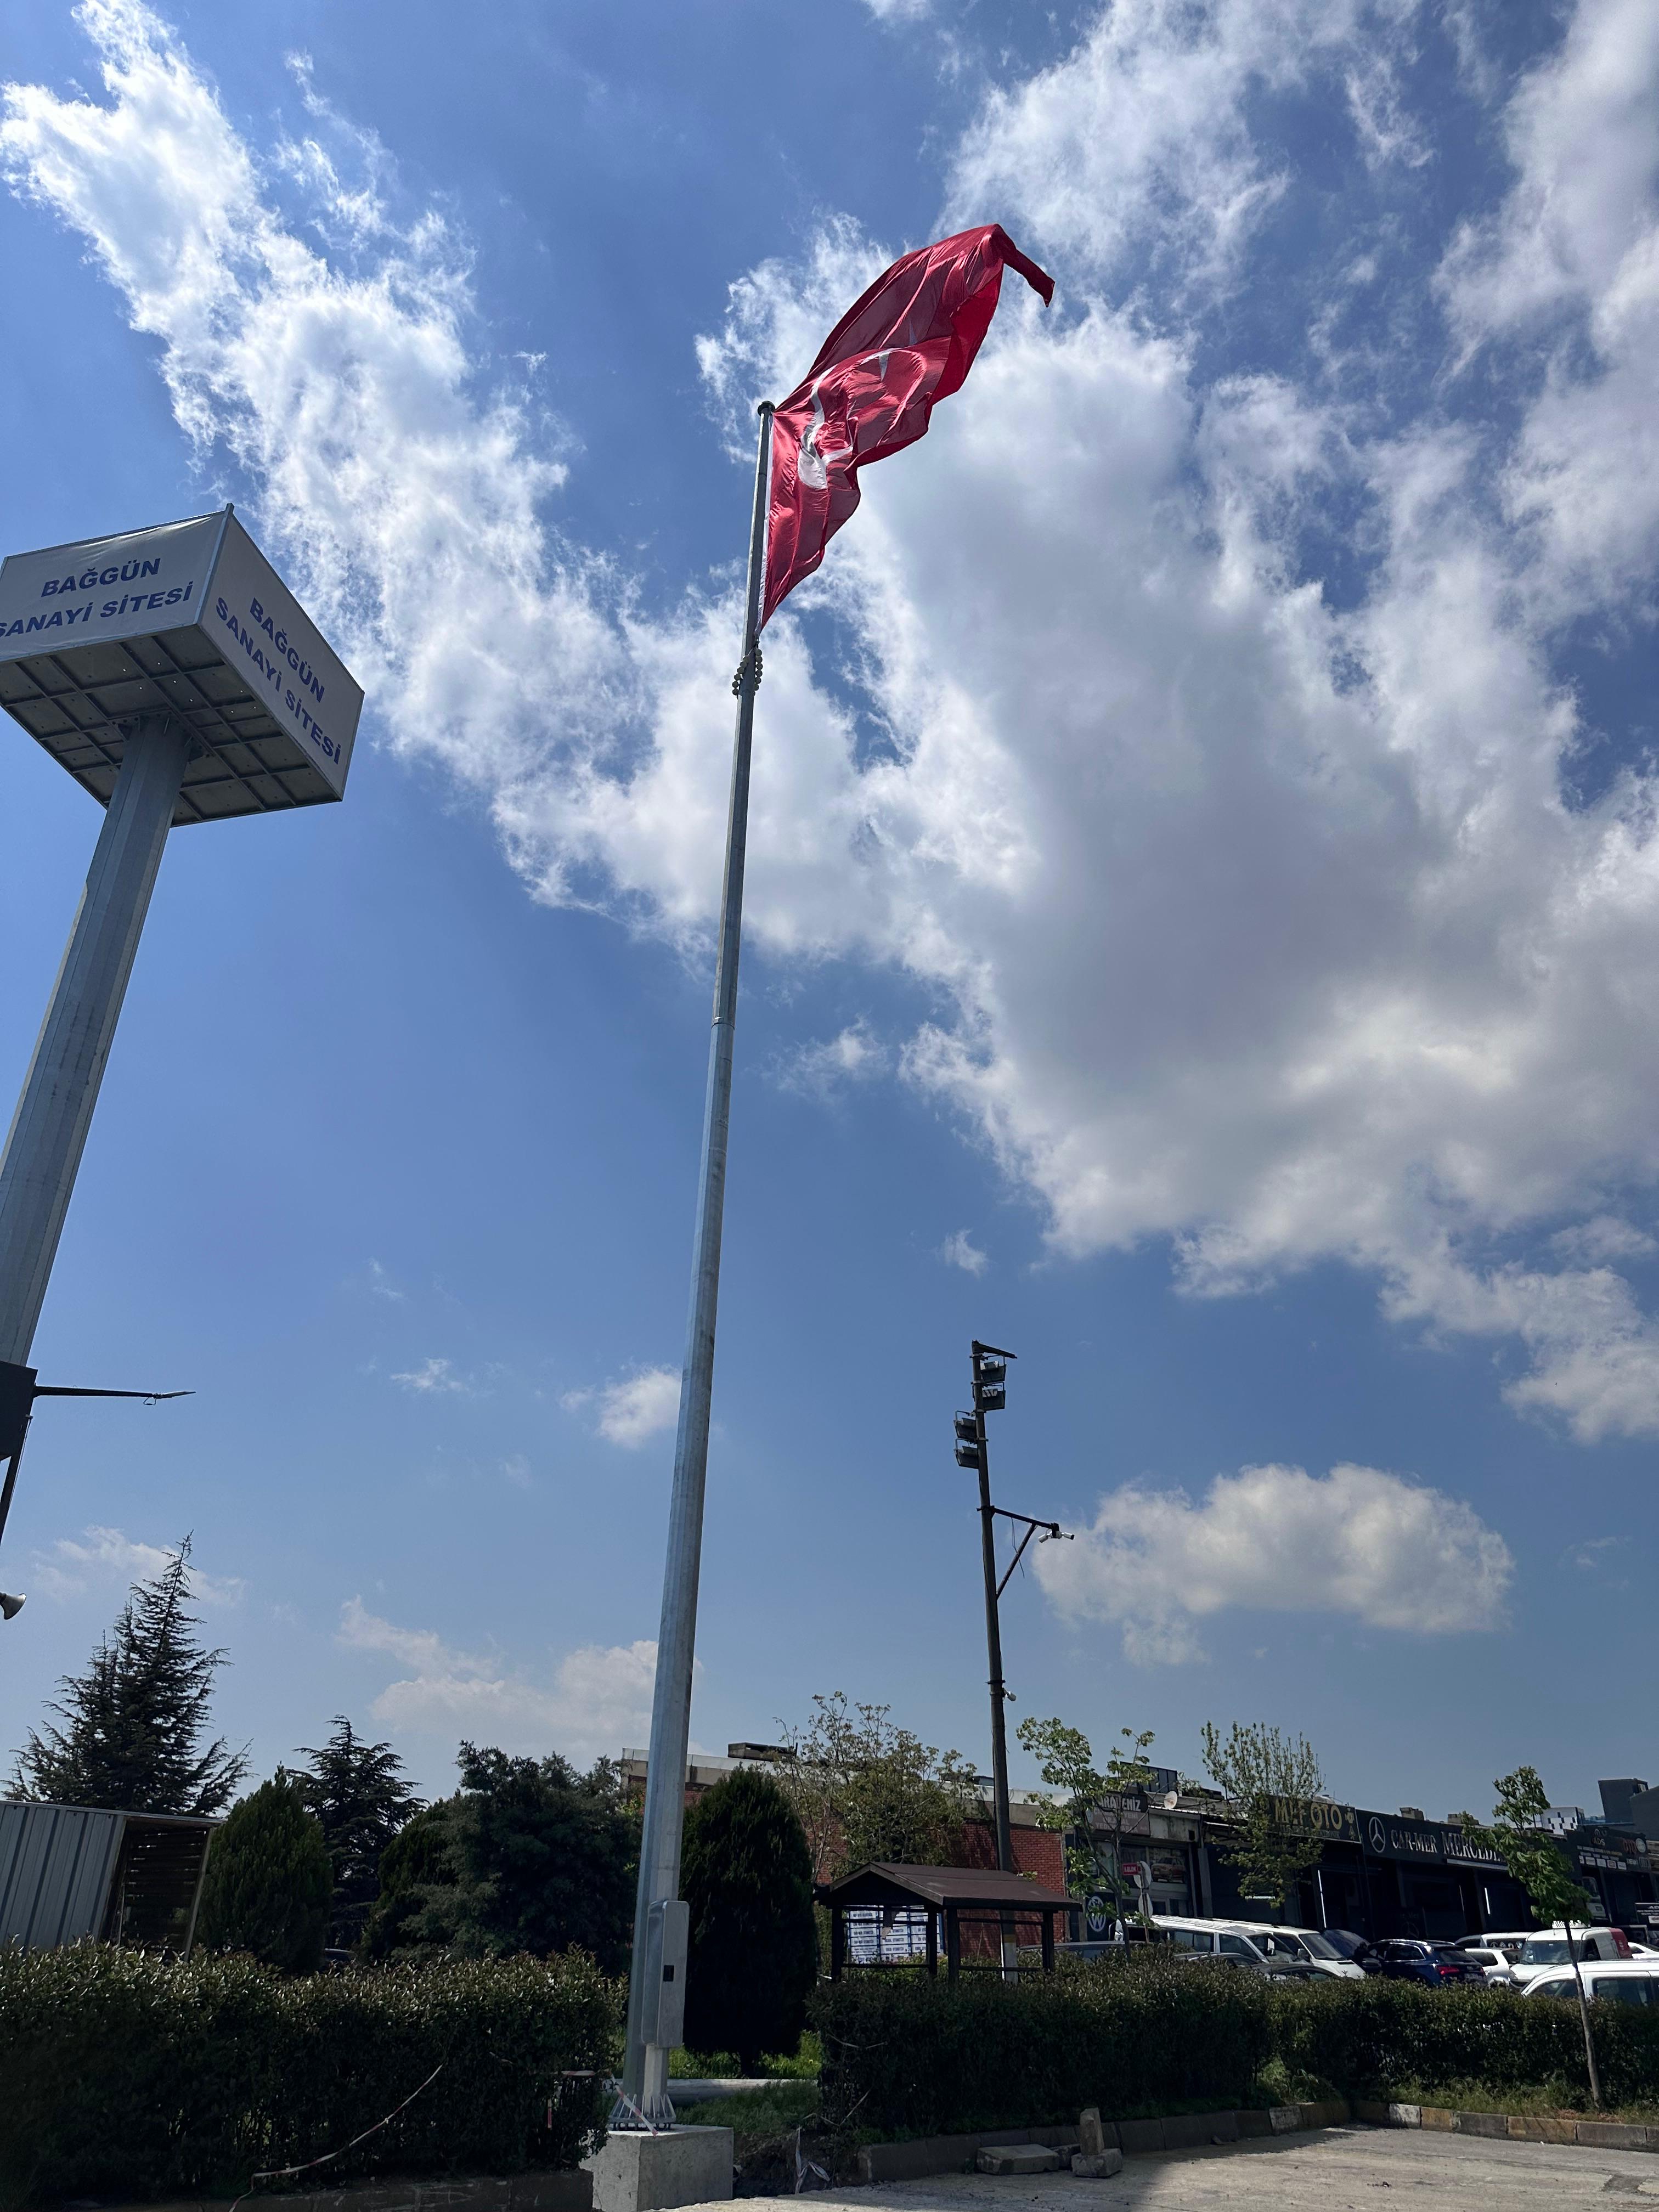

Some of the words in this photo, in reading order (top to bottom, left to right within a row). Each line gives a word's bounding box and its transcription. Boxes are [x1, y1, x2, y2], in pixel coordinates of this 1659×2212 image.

[41, 558, 161, 597] BAĞGÜN
[0, 602, 93, 637] SANAYİ
[100, 581, 193, 618] SİTESİ
[250, 597, 325, 703] BAĞGÜN
[216, 597, 281, 691] SANAYİ
[285, 689, 341, 764] SİTESİ
[1092, 1795, 1141, 1812] ARADENİZ
[1391, 1829, 1438, 1853] CAR-MER
